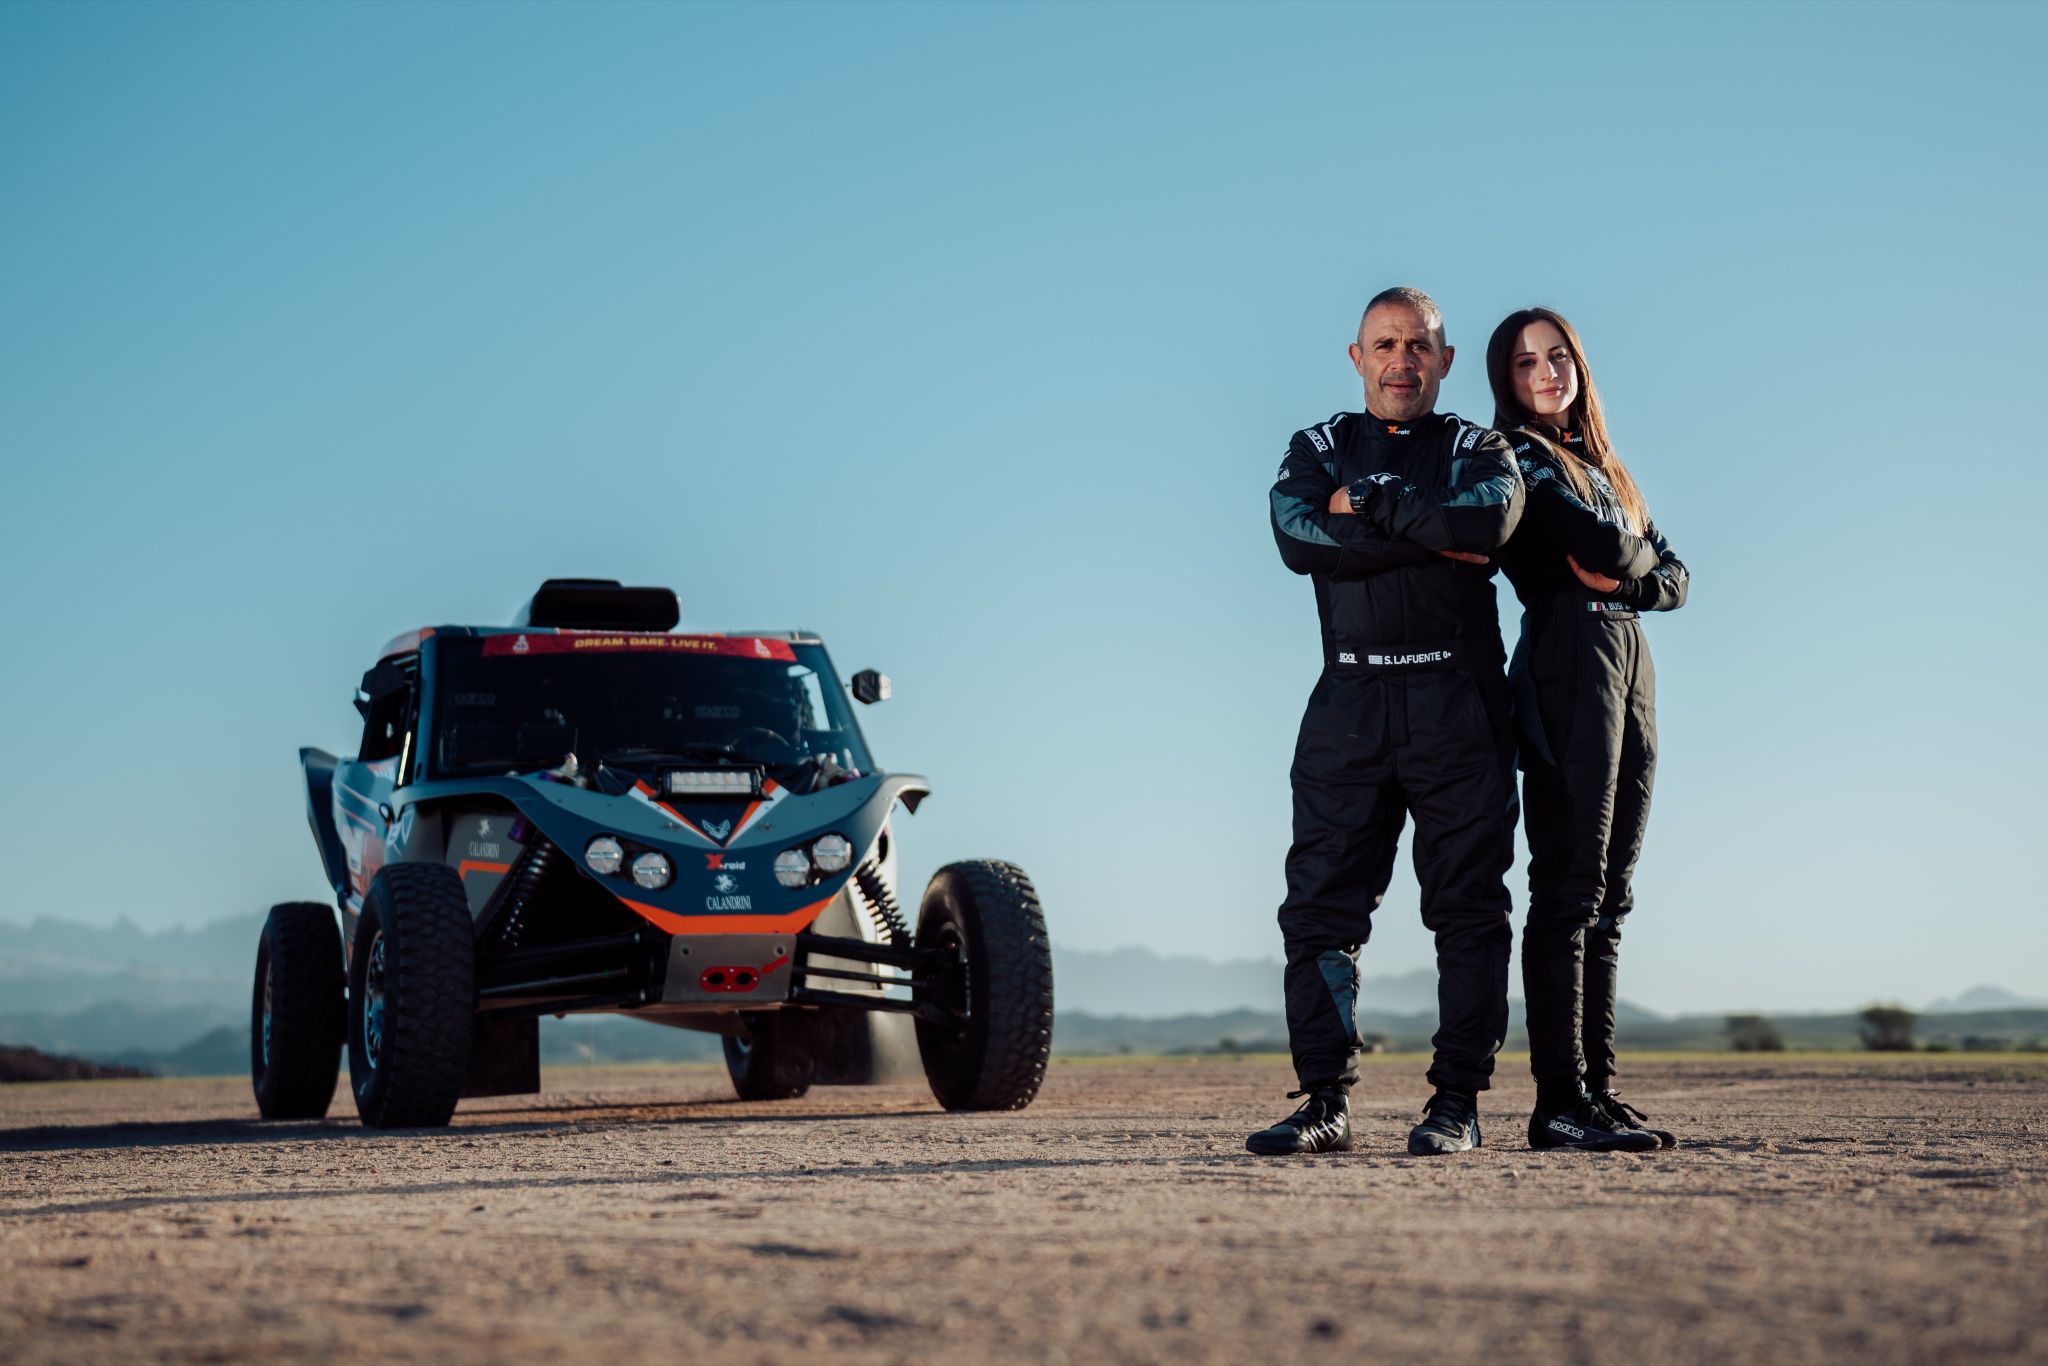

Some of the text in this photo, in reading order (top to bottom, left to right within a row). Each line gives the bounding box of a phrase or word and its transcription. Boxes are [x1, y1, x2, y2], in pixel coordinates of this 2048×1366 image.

[574, 637, 718, 651] DREAM. DARE. LIVE IT.
[1394, 651, 1442, 665] LAFUENTE
[705, 895, 752, 911] CALANDRINI
[1548, 1119, 1585, 1139] sparco
